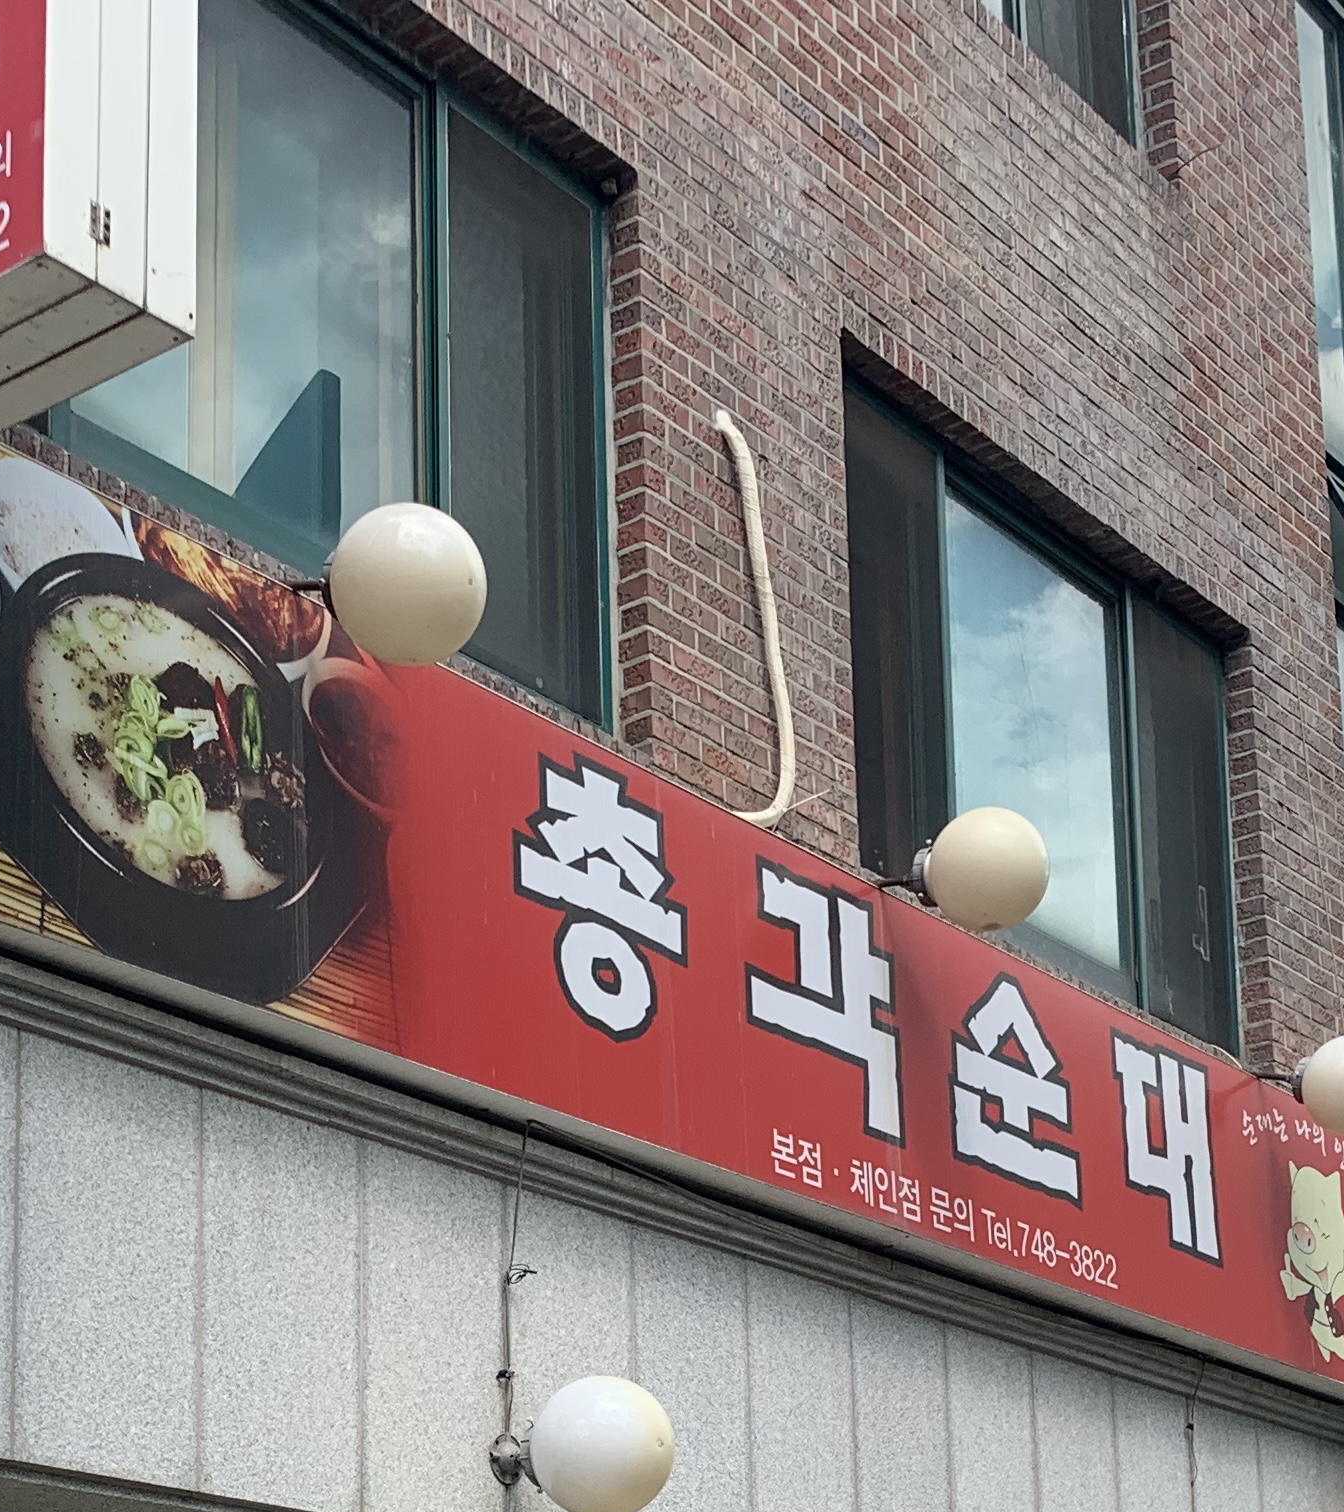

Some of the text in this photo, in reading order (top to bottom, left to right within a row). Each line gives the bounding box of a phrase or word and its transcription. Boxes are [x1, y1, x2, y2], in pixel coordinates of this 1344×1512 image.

[512, 753, 1224, 1267] 총각순대
[770, 1128, 822, 1189] 본점
[850, 1160, 921, 1223] 체인점
[930, 1187, 975, 1242] 문의
[1242, 1108, 1288, 1145] 순대는
[1295, 1120, 1326, 1156] 나의
